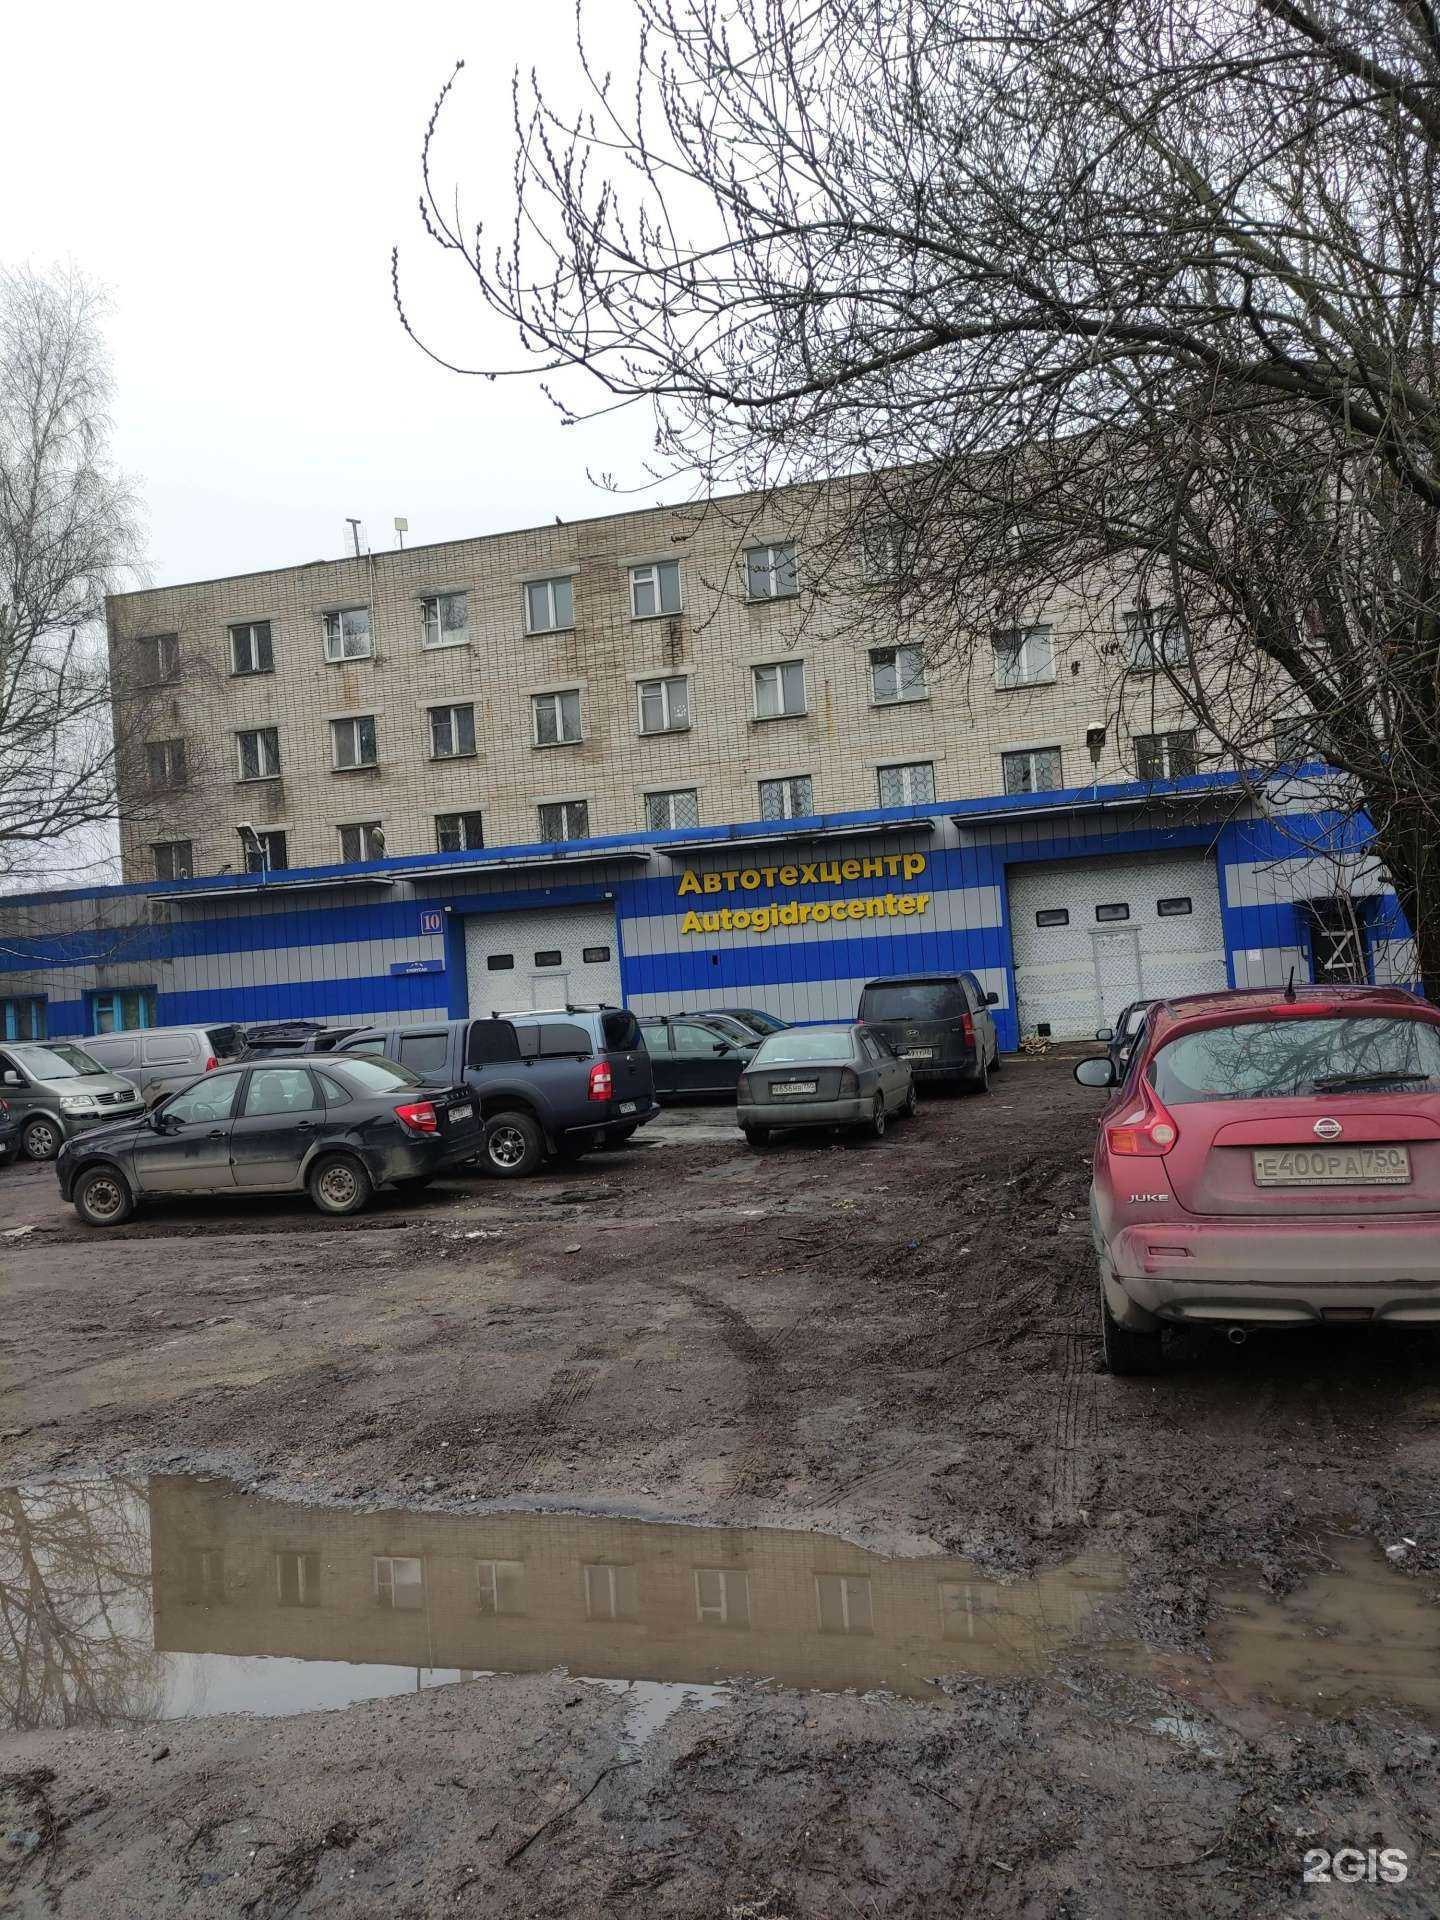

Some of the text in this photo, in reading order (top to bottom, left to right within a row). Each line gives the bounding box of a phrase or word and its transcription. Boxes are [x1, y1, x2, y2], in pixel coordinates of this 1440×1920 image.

[677, 853, 926, 896] Автотехцентр
[423, 914, 440, 929] 10
[680, 894, 929, 934] Autogidrocenter
[1362, 1149, 1401, 1168] 750
[1128, 1194, 1169, 1204] JUKE
